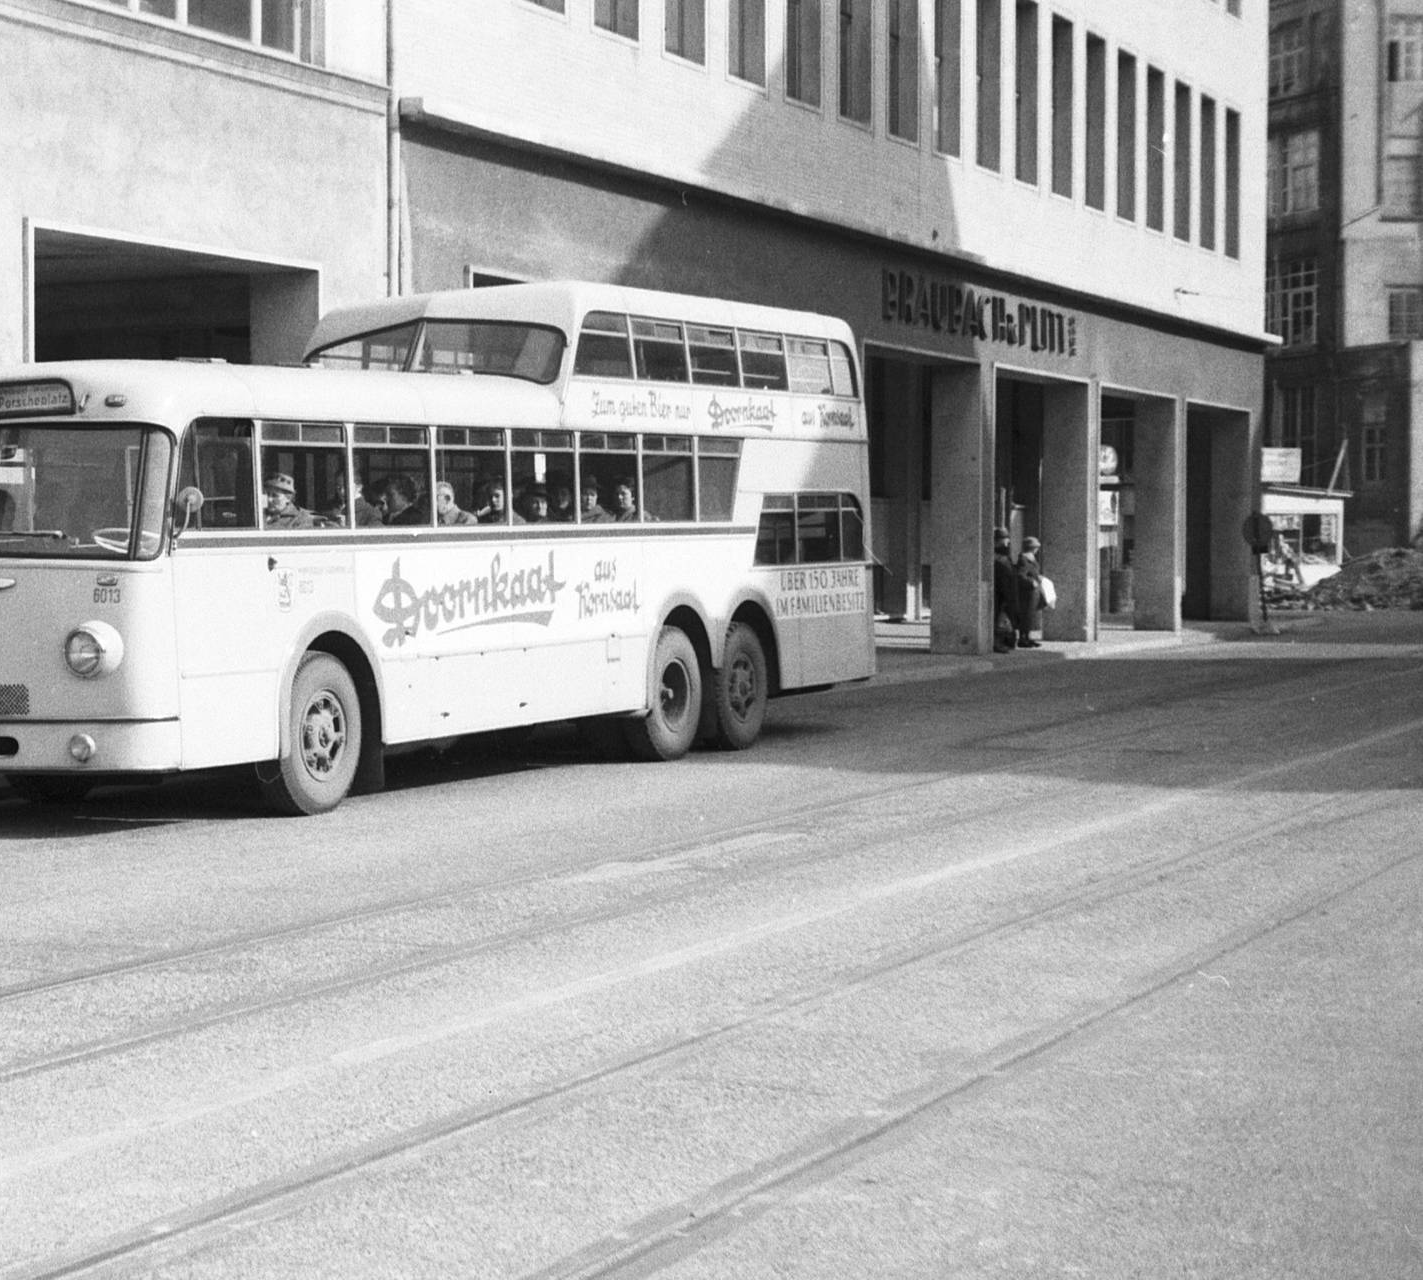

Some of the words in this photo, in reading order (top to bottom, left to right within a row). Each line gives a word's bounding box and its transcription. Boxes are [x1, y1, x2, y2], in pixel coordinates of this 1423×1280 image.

[708, 394, 777, 430] Doornkaat
[594, 557, 617, 582] aus
[809, 570, 828, 590] 150
[830, 568, 859, 589] JAHRE
[93, 588, 121, 604] 6013
[373, 550, 566, 648] Doornkaat
[575, 577, 641, 619] Kornsaat
[776, 597, 788, 617] IM
[790, 591, 865, 616] FAMILIENBESITZ
